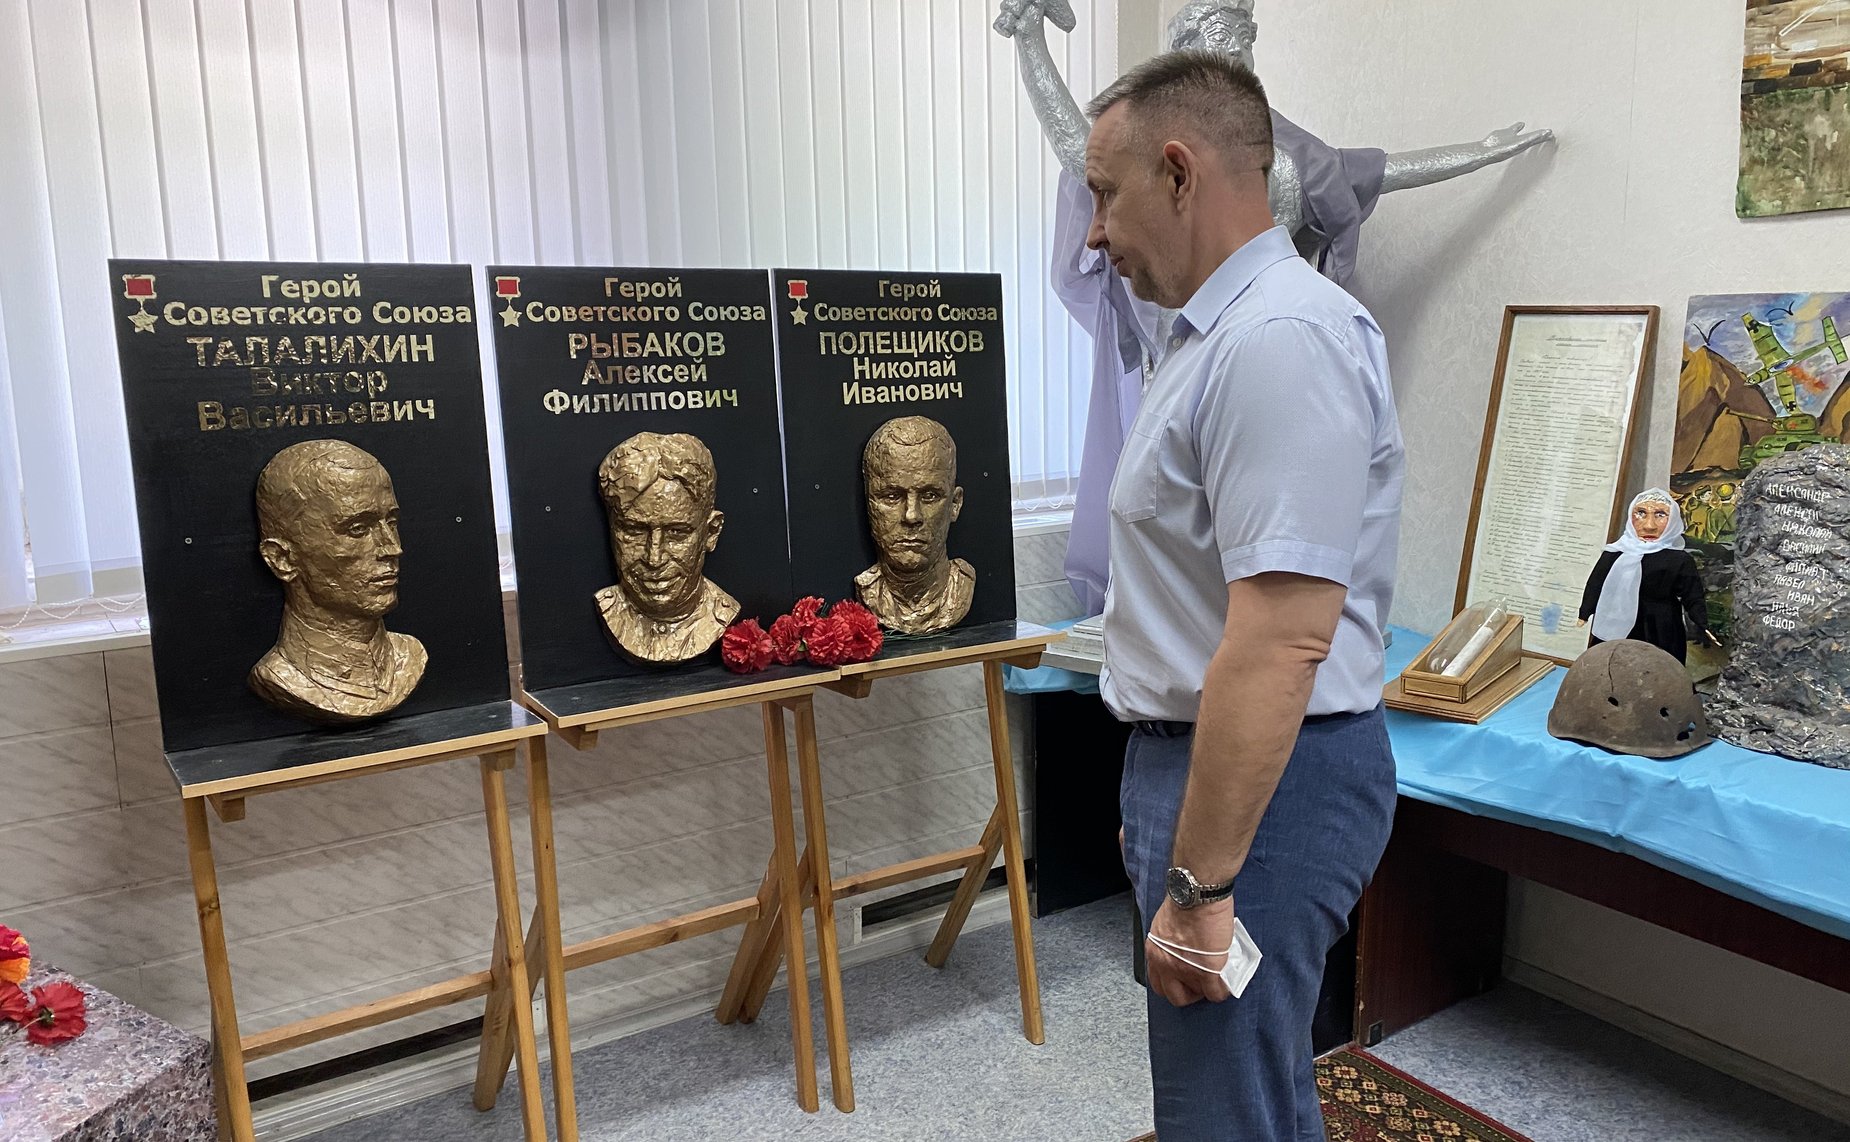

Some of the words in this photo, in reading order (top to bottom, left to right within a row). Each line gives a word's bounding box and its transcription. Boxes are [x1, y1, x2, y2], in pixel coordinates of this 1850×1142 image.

[261, 273, 362, 303] Герой
[604, 276, 682, 302] Герой
[878, 279, 942, 301] Герой
[163, 302, 362, 326] Советского
[372, 301, 472, 324] Союза
[526, 301, 680, 323] Советского
[687, 301, 766, 322] Союза
[813, 302, 933, 322] Советского
[937, 303, 998, 322] Союза
[186, 334, 435, 367] ТАЛАЛИХИН
[568, 331, 726, 359] РЫБАКОВ
[819, 330, 985, 358] ПОЛЕЩИКОВ
[581, 358, 708, 386] Алексей
[853, 354, 957, 380] Николай
[249, 366, 389, 398] Виктор
[842, 381, 964, 405] Иванович
[197, 399, 436, 431] Васильевич
[543, 388, 738, 415] Филиппович
